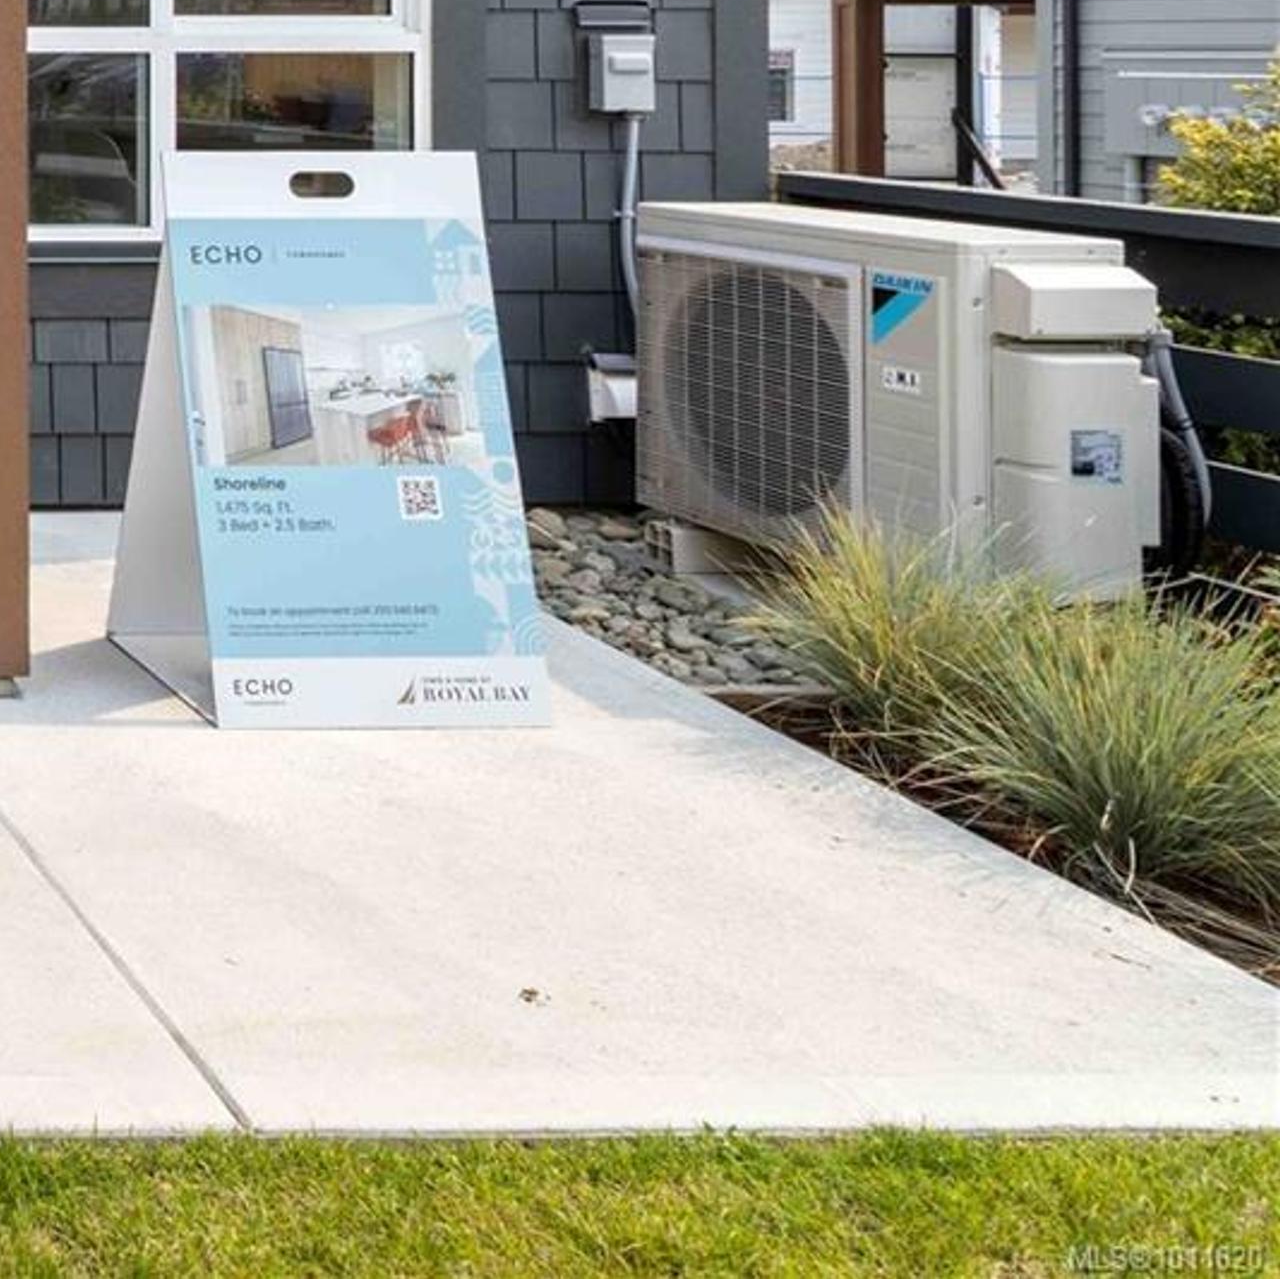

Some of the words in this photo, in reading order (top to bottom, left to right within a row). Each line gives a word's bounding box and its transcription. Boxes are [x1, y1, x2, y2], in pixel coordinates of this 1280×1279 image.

[190, 244, 262, 265] ECHO
[872, 272, 935, 294] DAIKIN
[213, 476, 286, 491] Shoreline
[230, 518, 259, 532] Bed
[233, 678, 292, 695] ECHO
[423, 686, 488, 702] ROYAL
